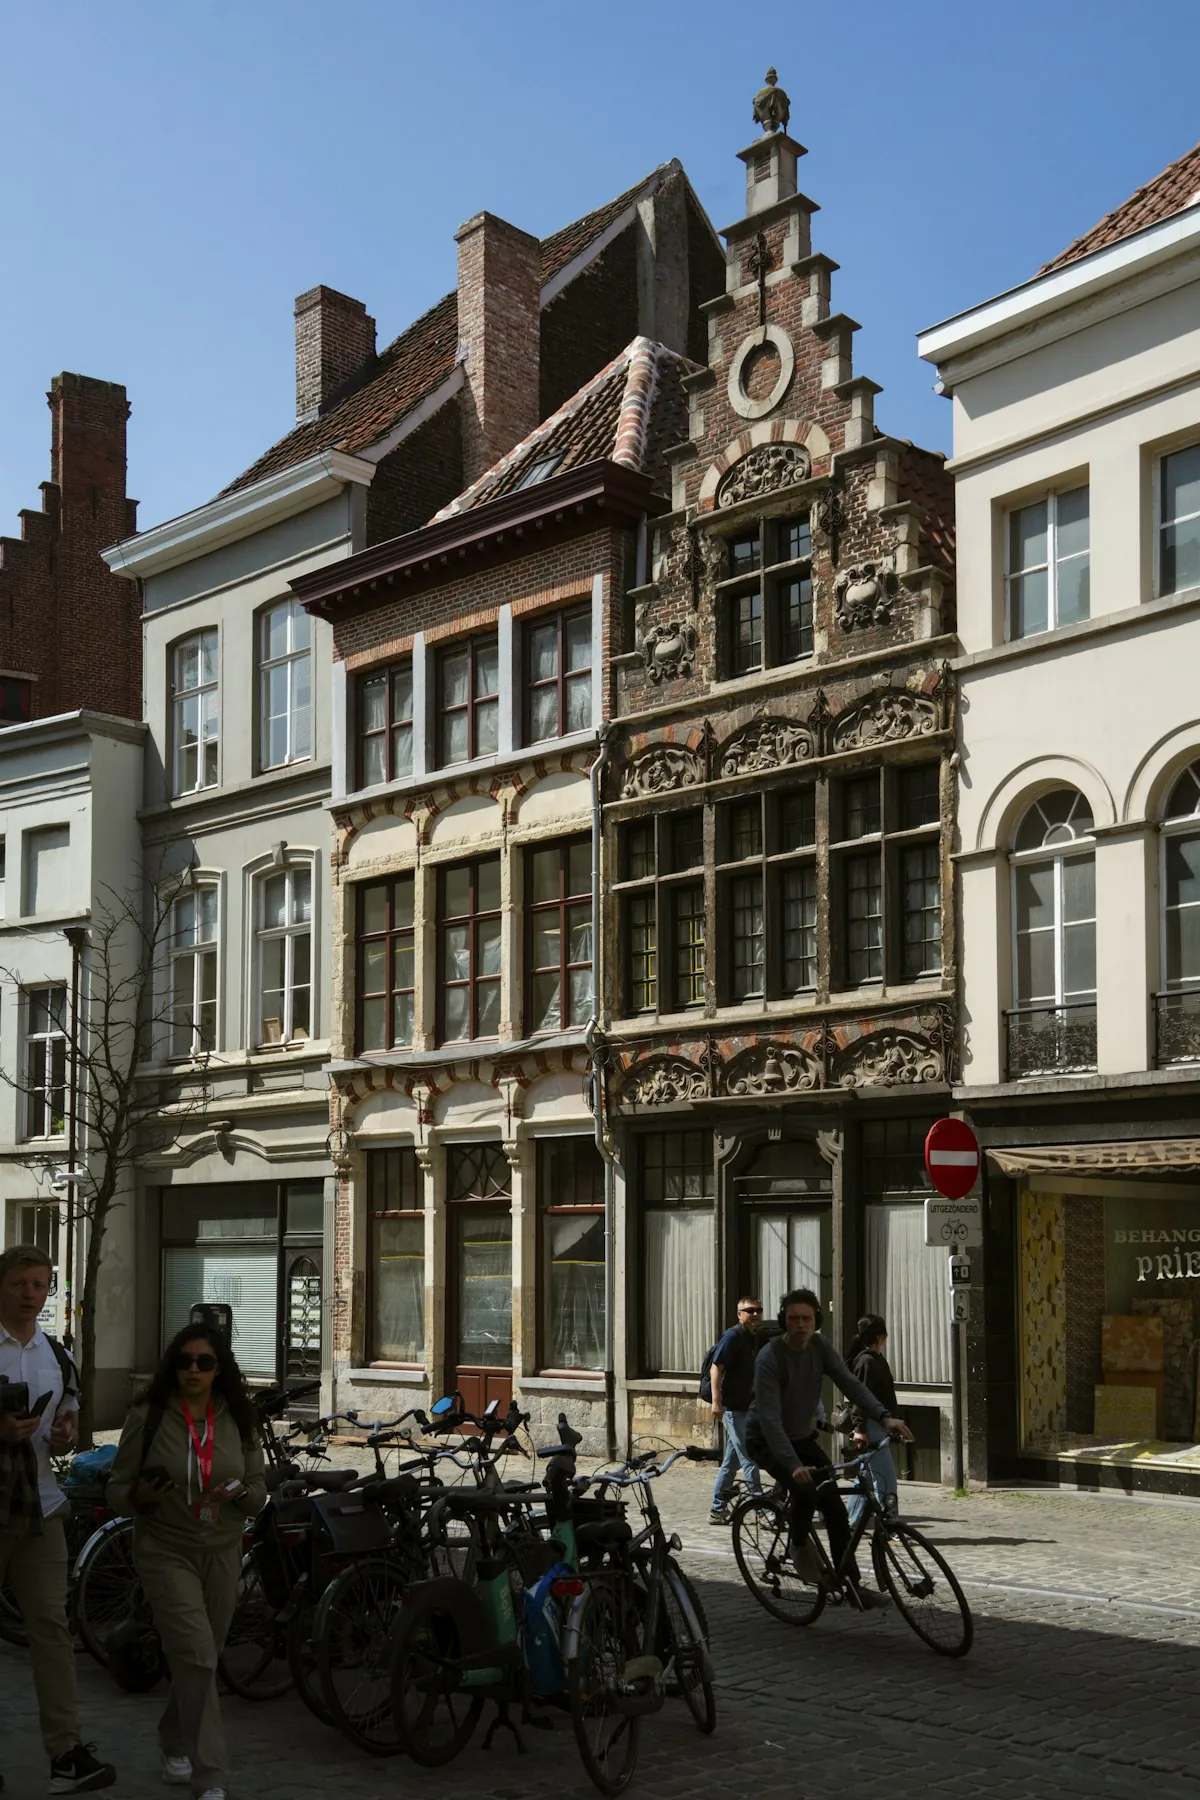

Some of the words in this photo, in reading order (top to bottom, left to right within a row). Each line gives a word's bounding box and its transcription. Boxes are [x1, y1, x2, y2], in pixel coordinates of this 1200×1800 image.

[930, 1204, 978, 1214] UITGEZONDERD
[1114, 1229, 1200, 1243] BEHANG
[499, 1585, 513, 1624] Bolt
